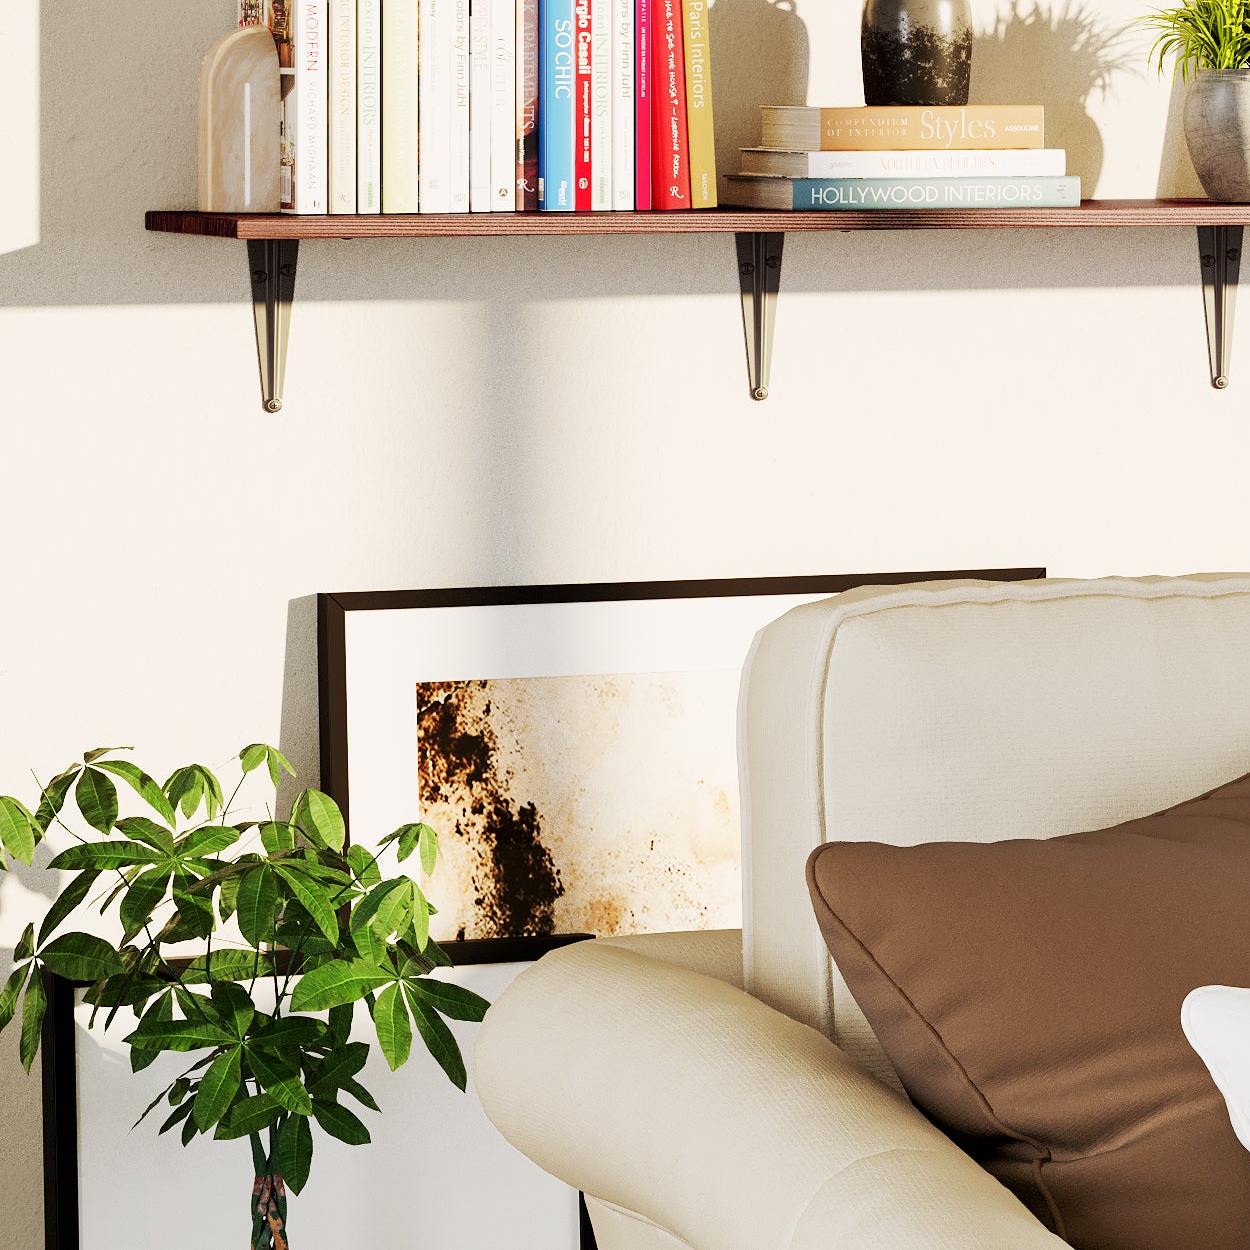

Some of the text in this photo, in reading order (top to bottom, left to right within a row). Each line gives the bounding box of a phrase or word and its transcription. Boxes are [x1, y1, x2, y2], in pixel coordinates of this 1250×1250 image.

[306, 4, 319, 71] MODERN
[620, 22, 632, 38] by
[666, 20, 674, 32] TO
[340, 15, 351, 68] INTERIOR
[454, 36, 466, 50] by
[474, 36, 488, 70] STYLE
[578, 31, 592, 74] Casali
[622, 42, 632, 69] Finn
[666, 34, 676, 50] SEE
[689, 2, 706, 108] Paris Interiors
[456, 54, 467, 80] Finn
[555, 20, 571, 100] SO CHIC
[668, 52, 676, 70] THE
[362, 46, 376, 126] INTERIORS
[520, 22, 535, 129] APARTMENTS
[594, 33, 609, 118] INTERIORS
[622, 72, 632, 98] Juhl
[306, 81, 317, 130] RICHARD
[340, 73, 351, 116] DESIGN
[456, 82, 467, 108] Juhl
[827, 118, 908, 126] COMPENDIUM
[827, 128, 842, 137] OF
[848, 128, 908, 136] INTERIOR
[920, 108, 996, 148] Styles
[306, 136, 317, 190] MISHAAN
[811, 186, 939, 205] HOLLYWOOD
[944, 184, 1044, 202] INTERIORS
